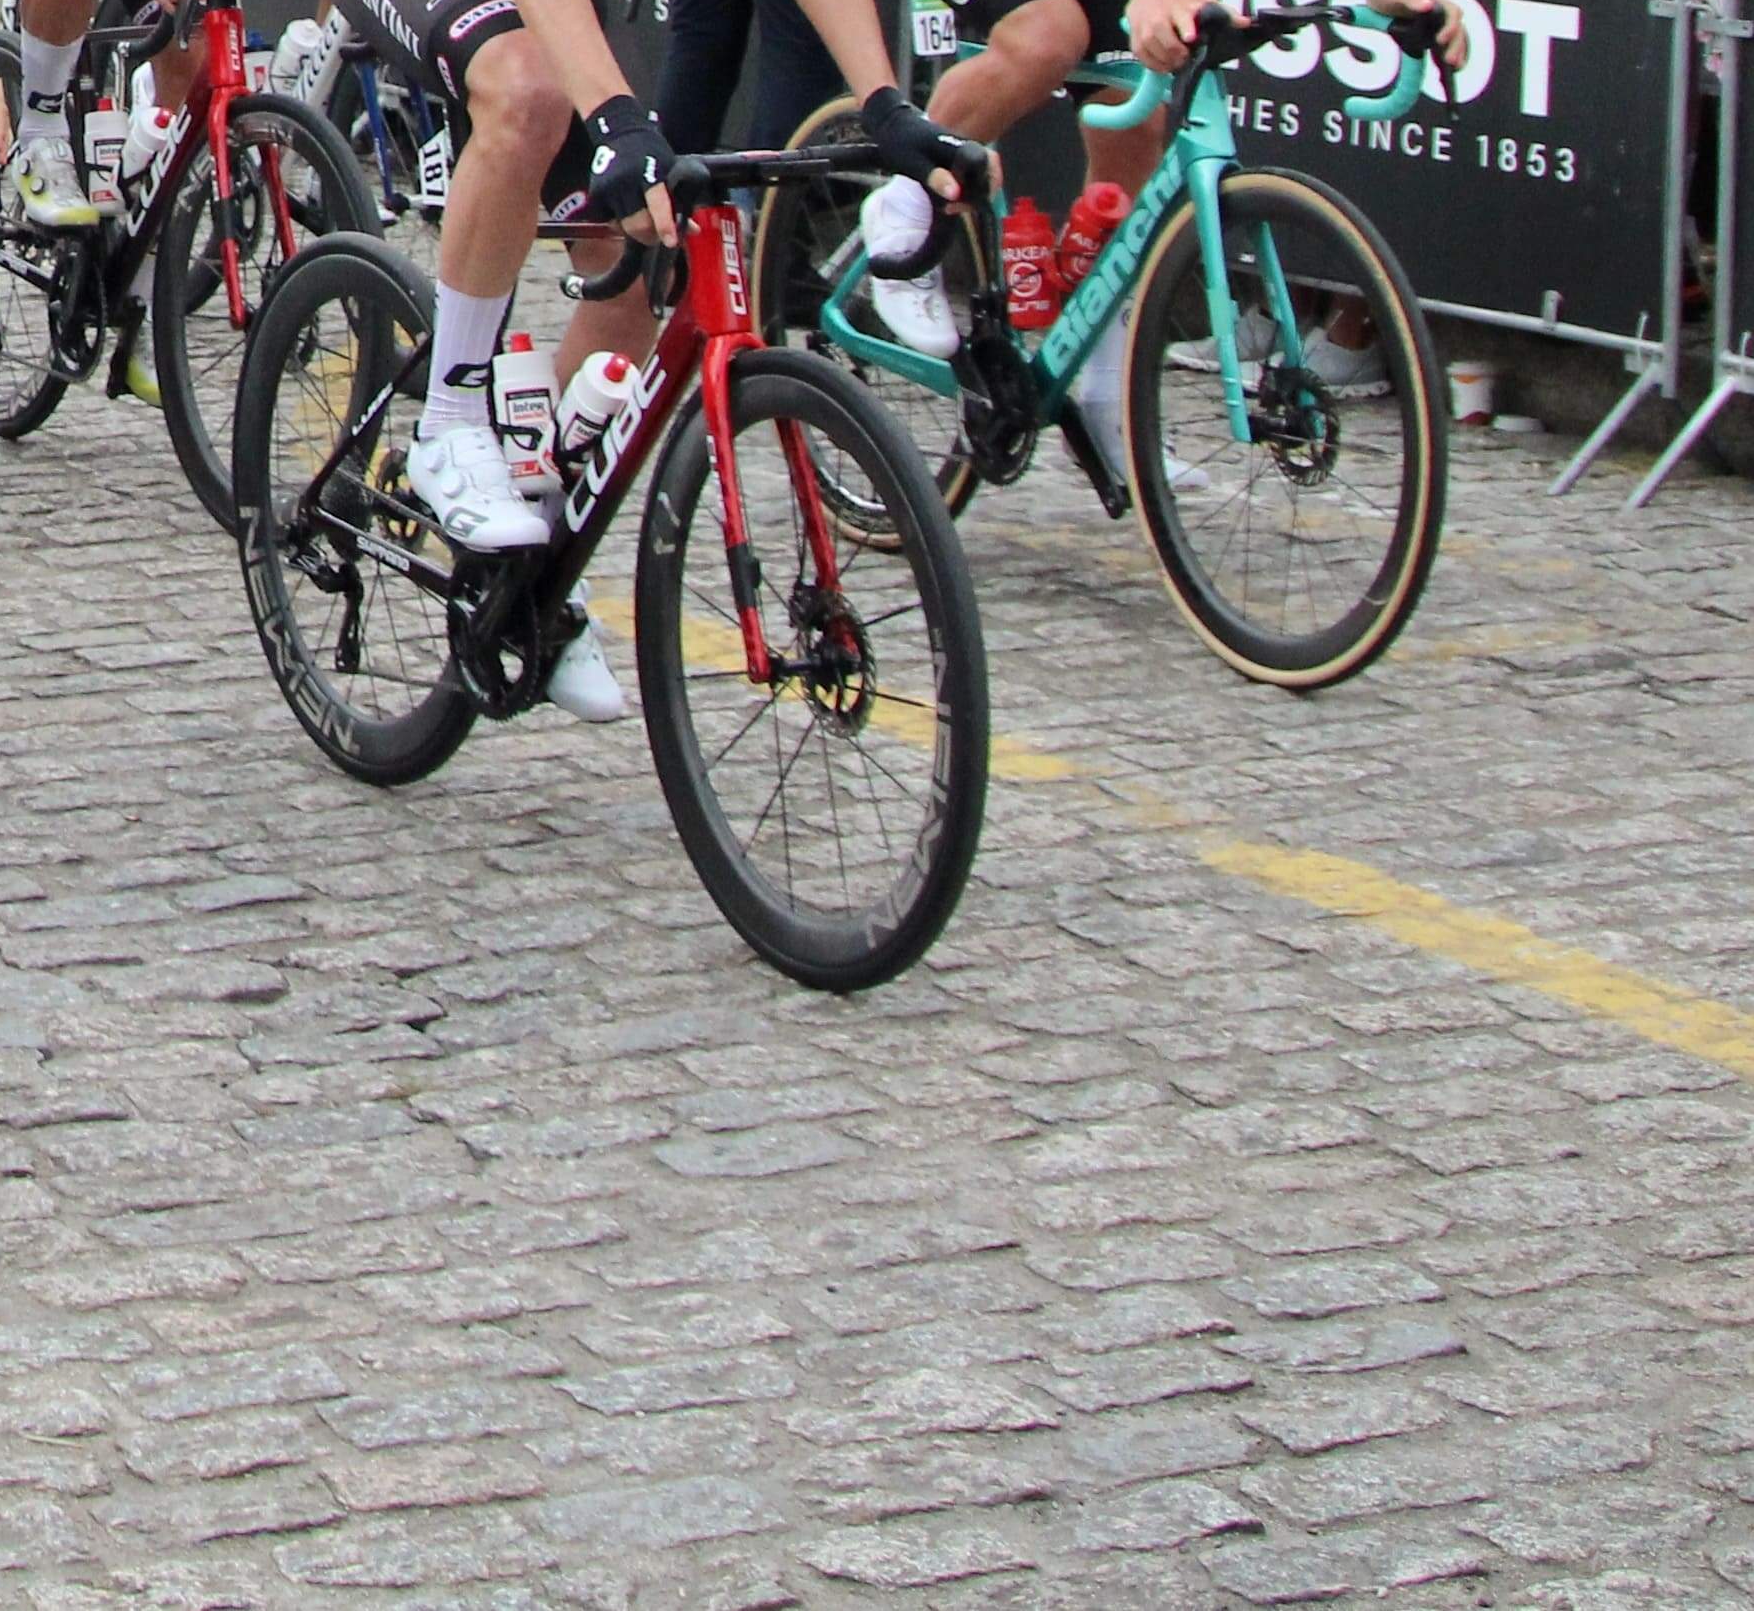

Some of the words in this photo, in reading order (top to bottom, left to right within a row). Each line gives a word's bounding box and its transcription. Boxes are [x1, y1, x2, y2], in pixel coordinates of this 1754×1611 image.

[228, 21, 241, 73] CUBE
[917, 16, 954, 51] 164
[127, 99, 192, 238] CUBE
[419, 142, 448, 208] 187
[1322, 106, 1453, 162] SINCE
[1475, 134, 1578, 184] 1853
[722, 217, 751, 317] CUBE
[1041, 148, 1187, 380] Bianchi
[565, 353, 669, 535] CUBE
